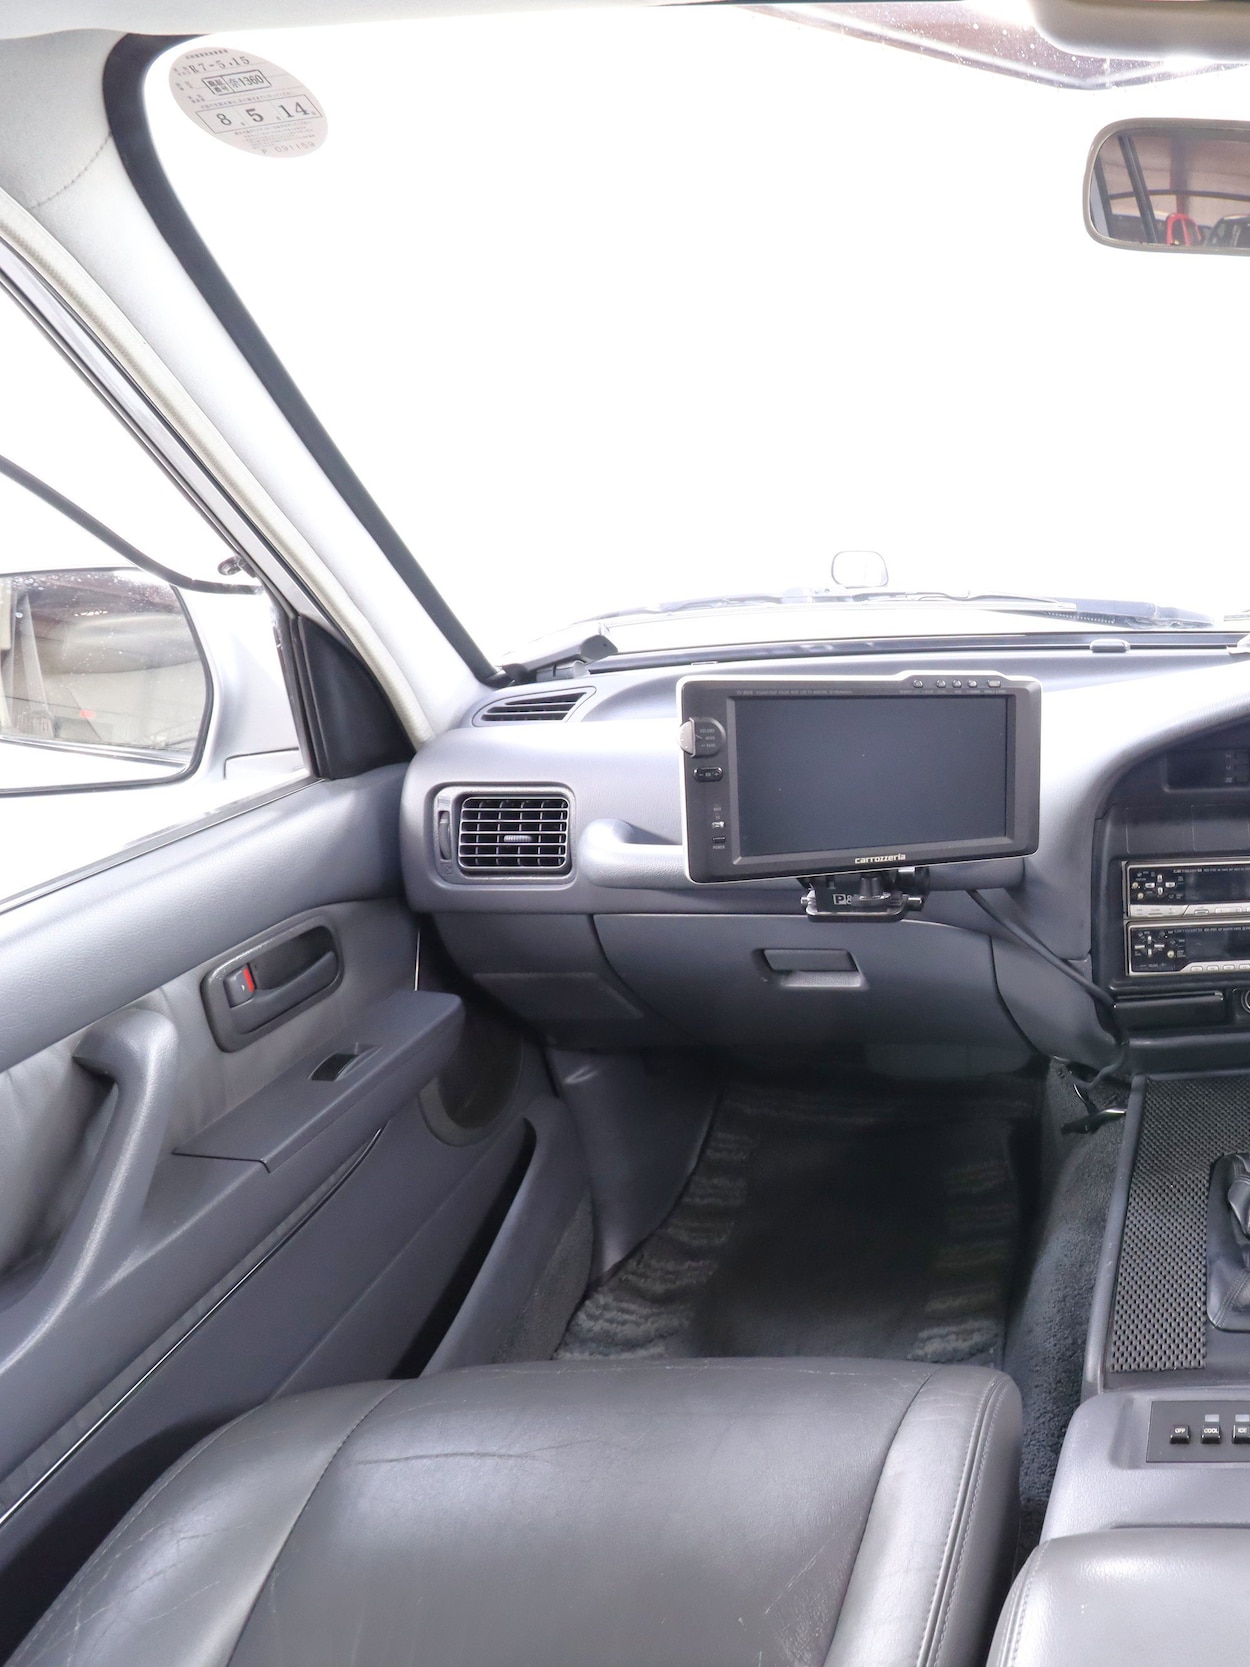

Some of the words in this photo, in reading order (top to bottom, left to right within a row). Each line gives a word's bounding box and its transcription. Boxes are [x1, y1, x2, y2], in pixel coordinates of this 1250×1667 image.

[216, 113, 232, 126] 8
[245, 108, 264, 122] 5
[278, 102, 310, 118] 14
[854, 853, 906, 864] carrozzeria
